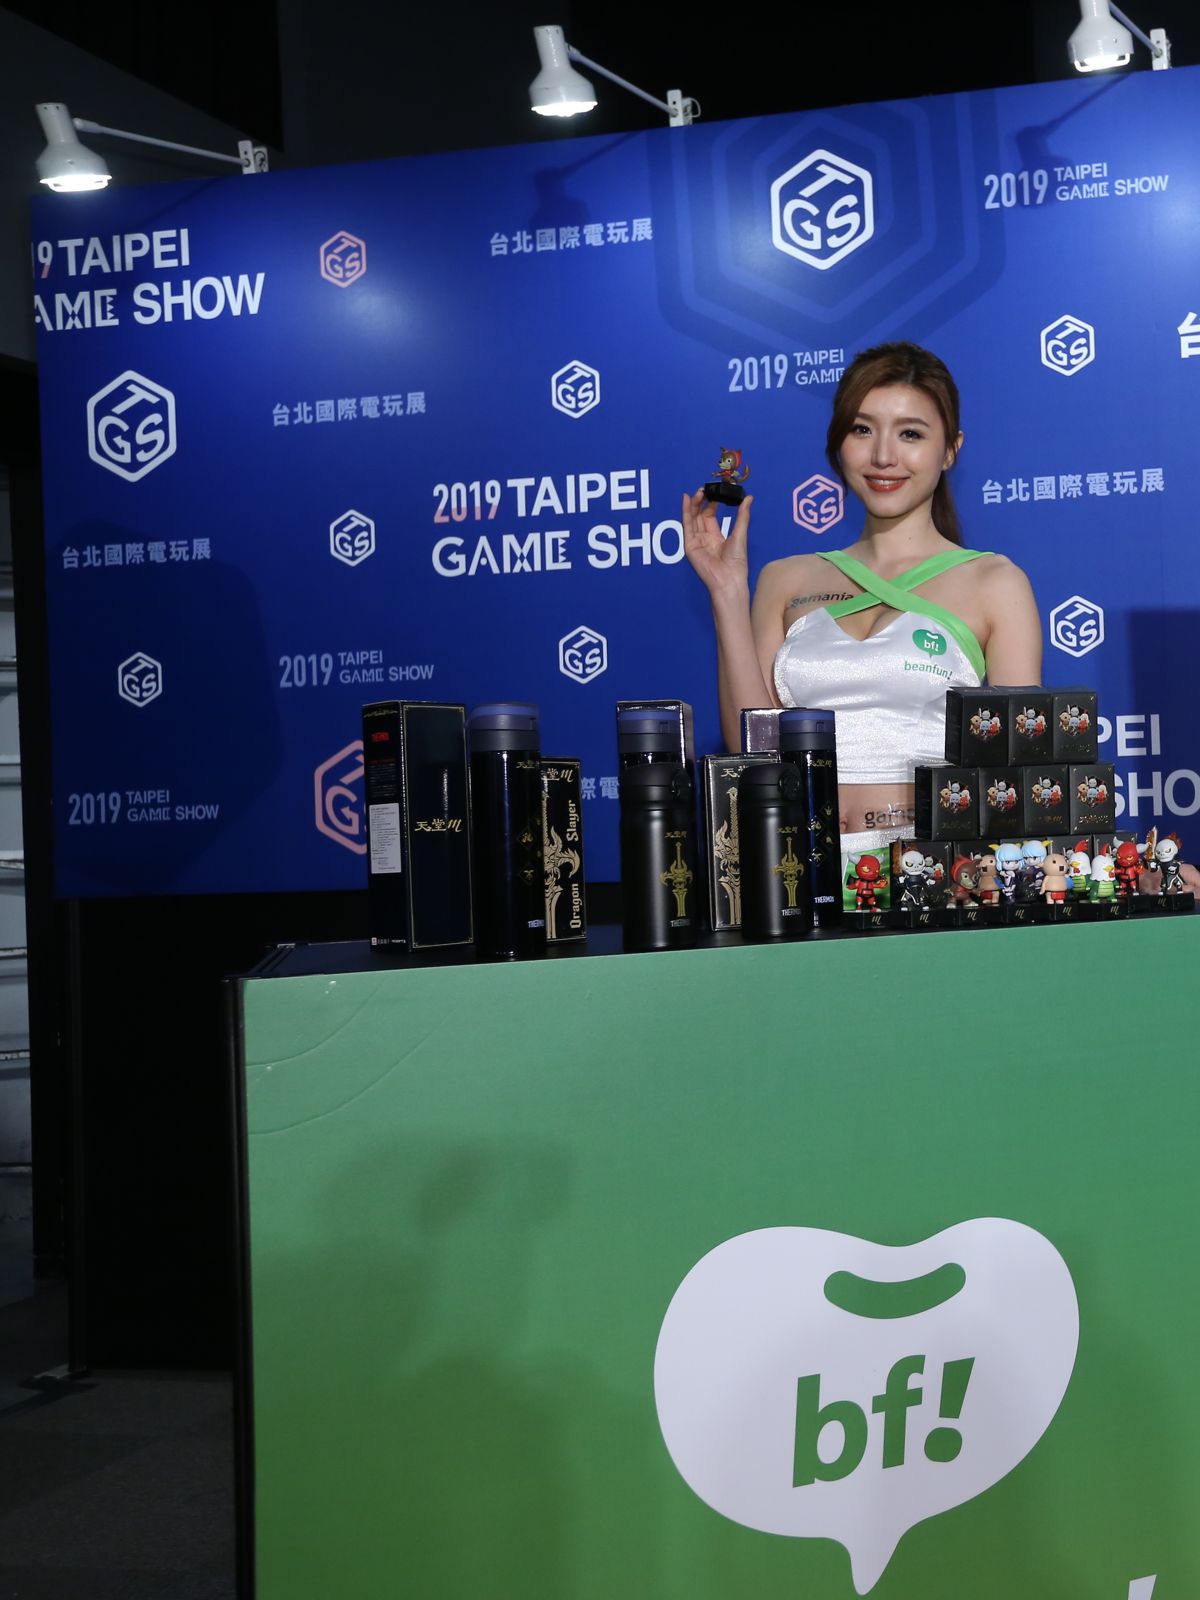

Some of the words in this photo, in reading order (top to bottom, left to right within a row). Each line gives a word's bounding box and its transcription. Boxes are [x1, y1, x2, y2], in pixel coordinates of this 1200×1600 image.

[1053, 162, 1107, 181] TAIPEI
[1055, 183, 1109, 201] GAME
[1114, 174, 1169, 195] SHOW
[984, 169, 1048, 209] 2019
[58, 228, 190, 276] TAIPEI
[489, 217, 654, 256] 台北國際電玩展
[133, 272, 265, 325] SHOW
[728, 353, 788, 392] 2019
[793, 348, 845, 366] TAIPEI
[271, 391, 427, 426] 台北國際電玩展
[433, 480, 501, 523] 2019
[507, 469, 650, 517] TAIPEI
[981, 467, 1166, 505] 台北國際電玩展
[61, 537, 211, 570] 台北國際電玩展
[432, 530, 571, 577] GAME
[338, 650, 383, 666] TAIPEI
[924, 639, 939, 651] bf!
[279, 654, 333, 688] 2019
[339, 667, 384, 684] GAME
[388, 664, 434, 682] SHOW
[904, 661, 953, 680] beanfun!
[68, 792, 121, 825] 2019
[126, 790, 170, 804] TAIPEI
[127, 806, 172, 821] GAME
[176, 803, 219, 820] SHOW
[566, 800, 580, 842] Slayer
[570, 883, 584, 930] Dragon
[792, 1354, 975, 1488] bf!
